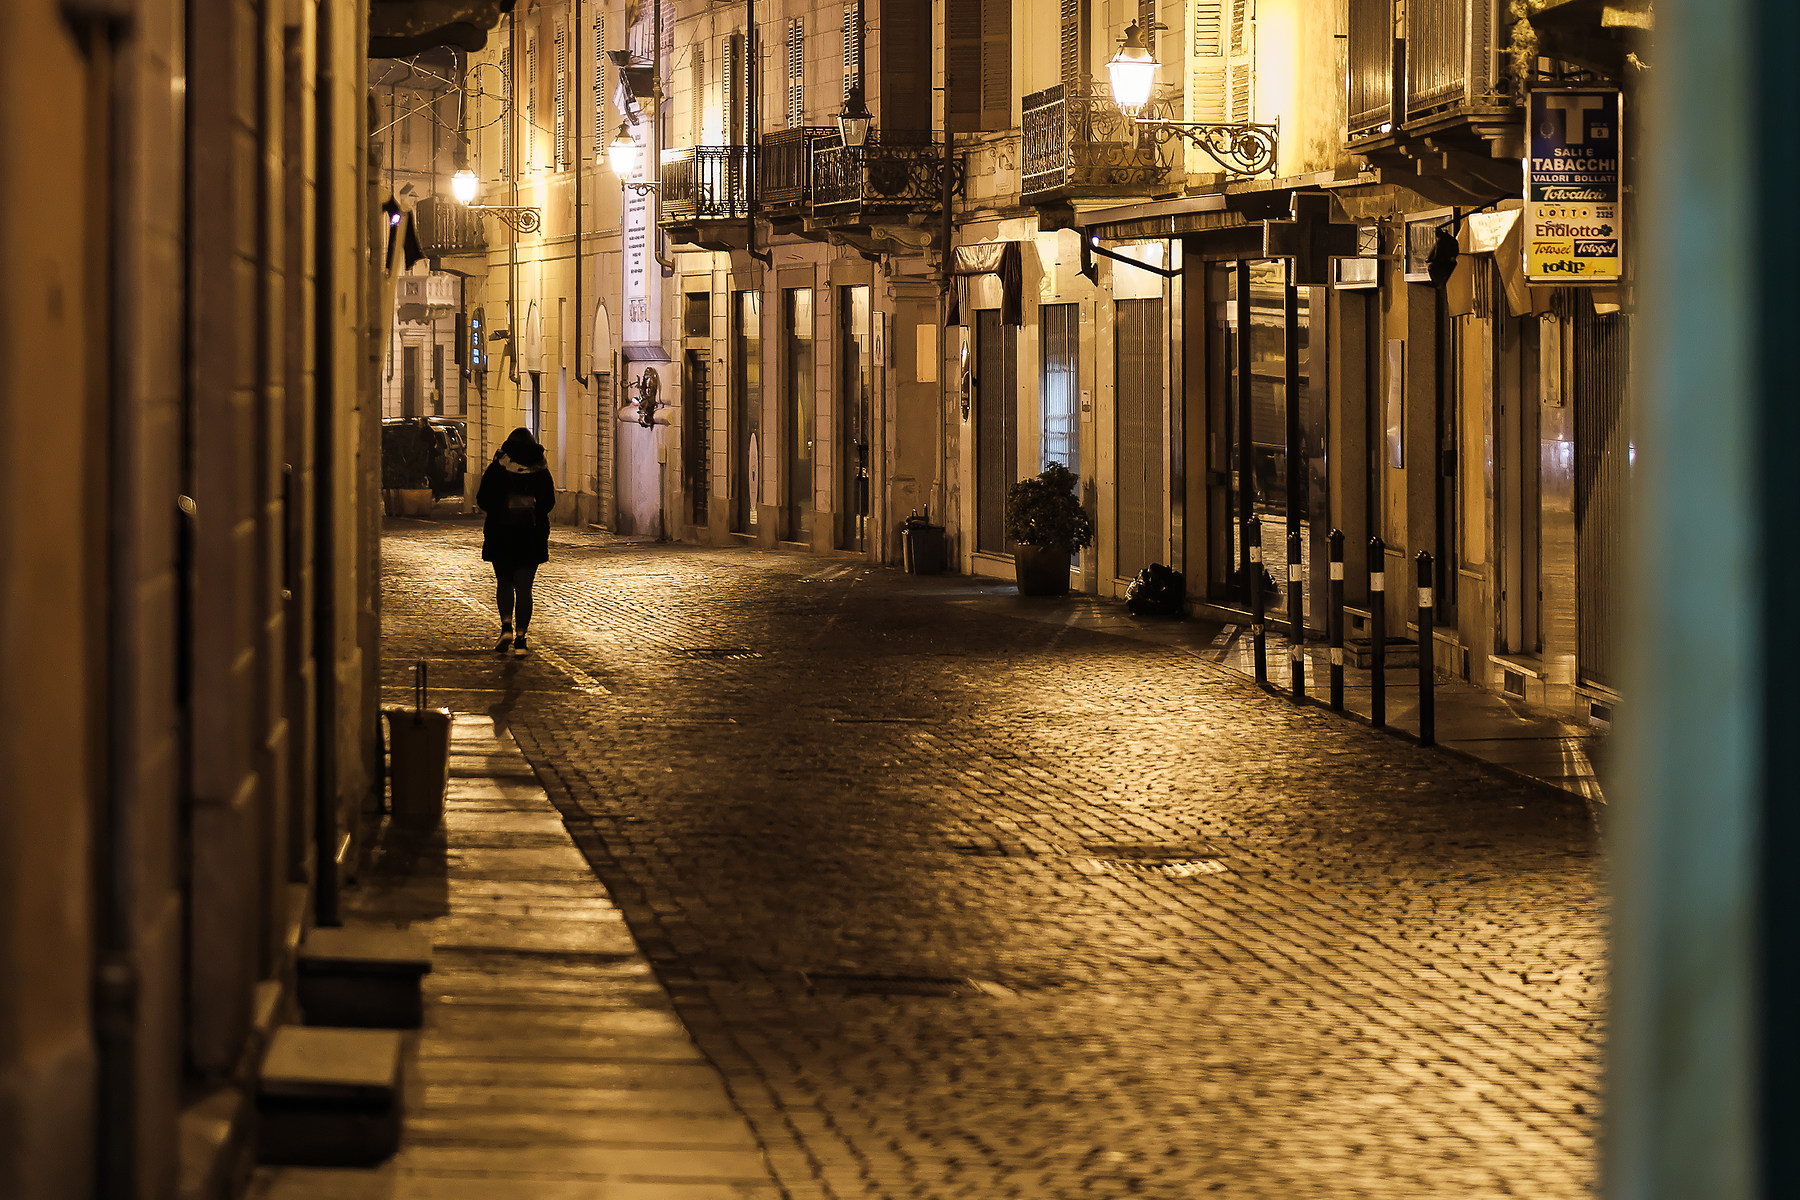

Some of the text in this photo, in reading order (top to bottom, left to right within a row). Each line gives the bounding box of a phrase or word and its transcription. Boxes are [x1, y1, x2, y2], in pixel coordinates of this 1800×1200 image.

[1546, 96, 1604, 144] T
[1553, 147, 1594, 157] SALI E
[1532, 158, 1616, 171] TABACCHI
[1532, 174, 1616, 182] VALORI BOLLATI
[1539, 185, 1607, 201] Totocalcio
[1596, 211, 1614, 219] 2325
[1535, 224, 1600, 237] Enalotto
[1532, 240, 1616, 256] Totosei Totogol
[1542, 260, 1586, 274] totip
